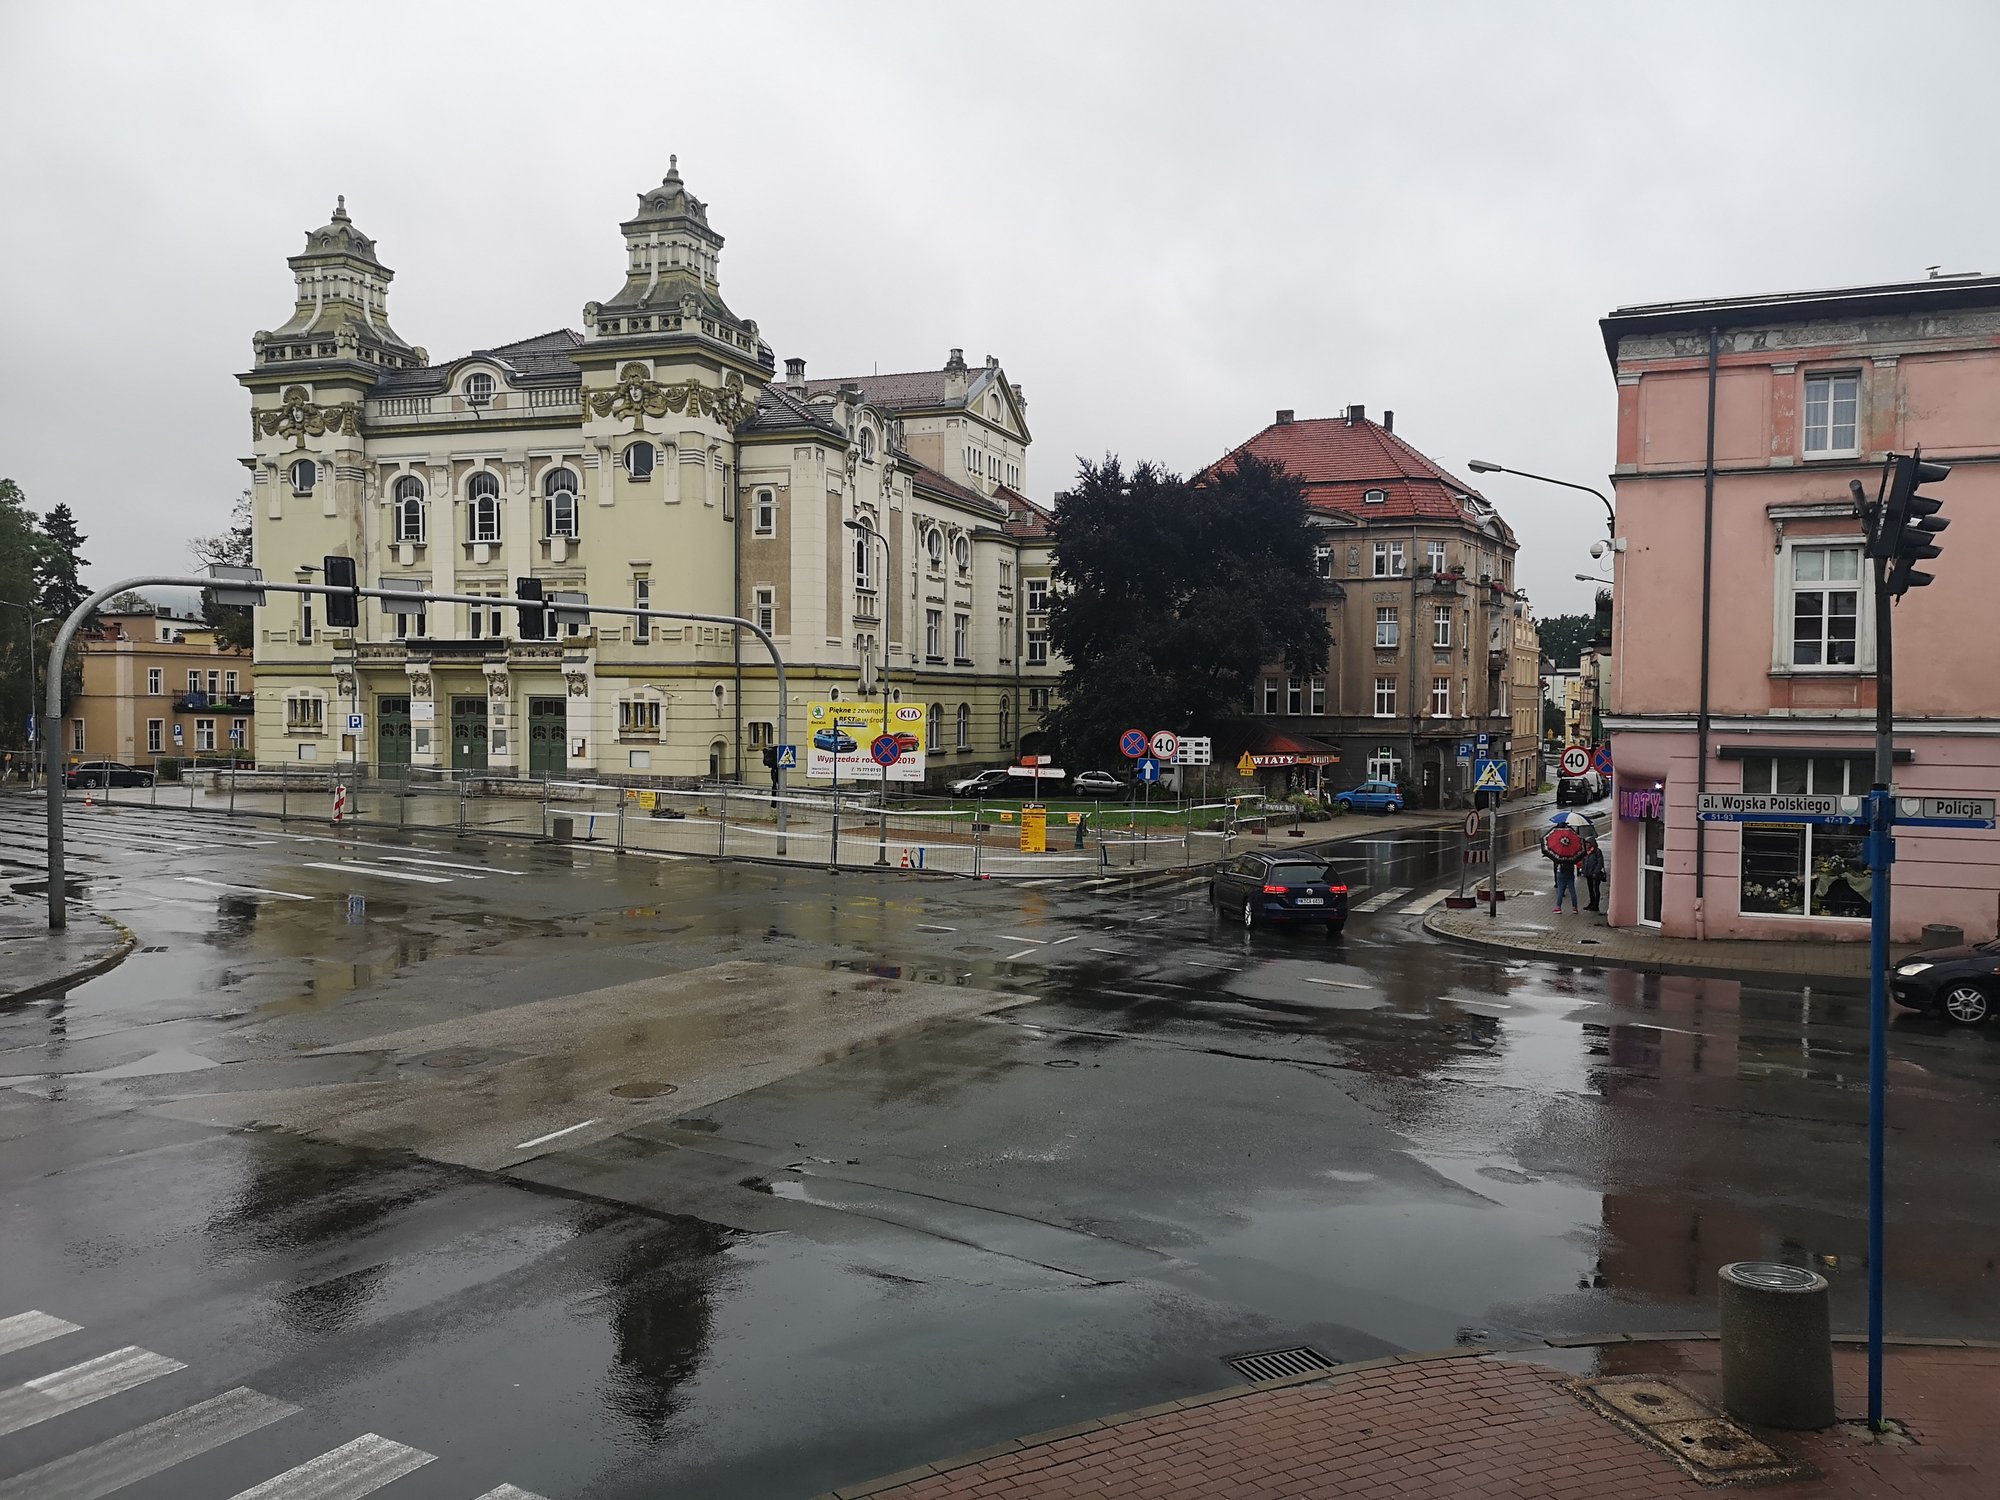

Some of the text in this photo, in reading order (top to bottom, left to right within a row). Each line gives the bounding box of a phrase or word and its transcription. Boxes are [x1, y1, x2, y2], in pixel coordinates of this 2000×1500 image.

[829, 706, 852, 714] Piękne
[900, 710, 918, 718] KIA
[351, 716, 360, 728] P
[1479, 734, 1487, 743] P
[1154, 738, 1175, 752] 40
[1460, 746, 1467, 755] P
[817, 755, 860, 764] Wypzedaż
[897, 757, 916, 765] 2019
[1252, 755, 1294, 764] WIATY
[1564, 753, 1585, 768] 40
[1703, 796, 1831, 814] al. Wojska Polskiego
[1936, 800, 1982, 818] Policja
[1824, 816, 1843, 824] 47-1
